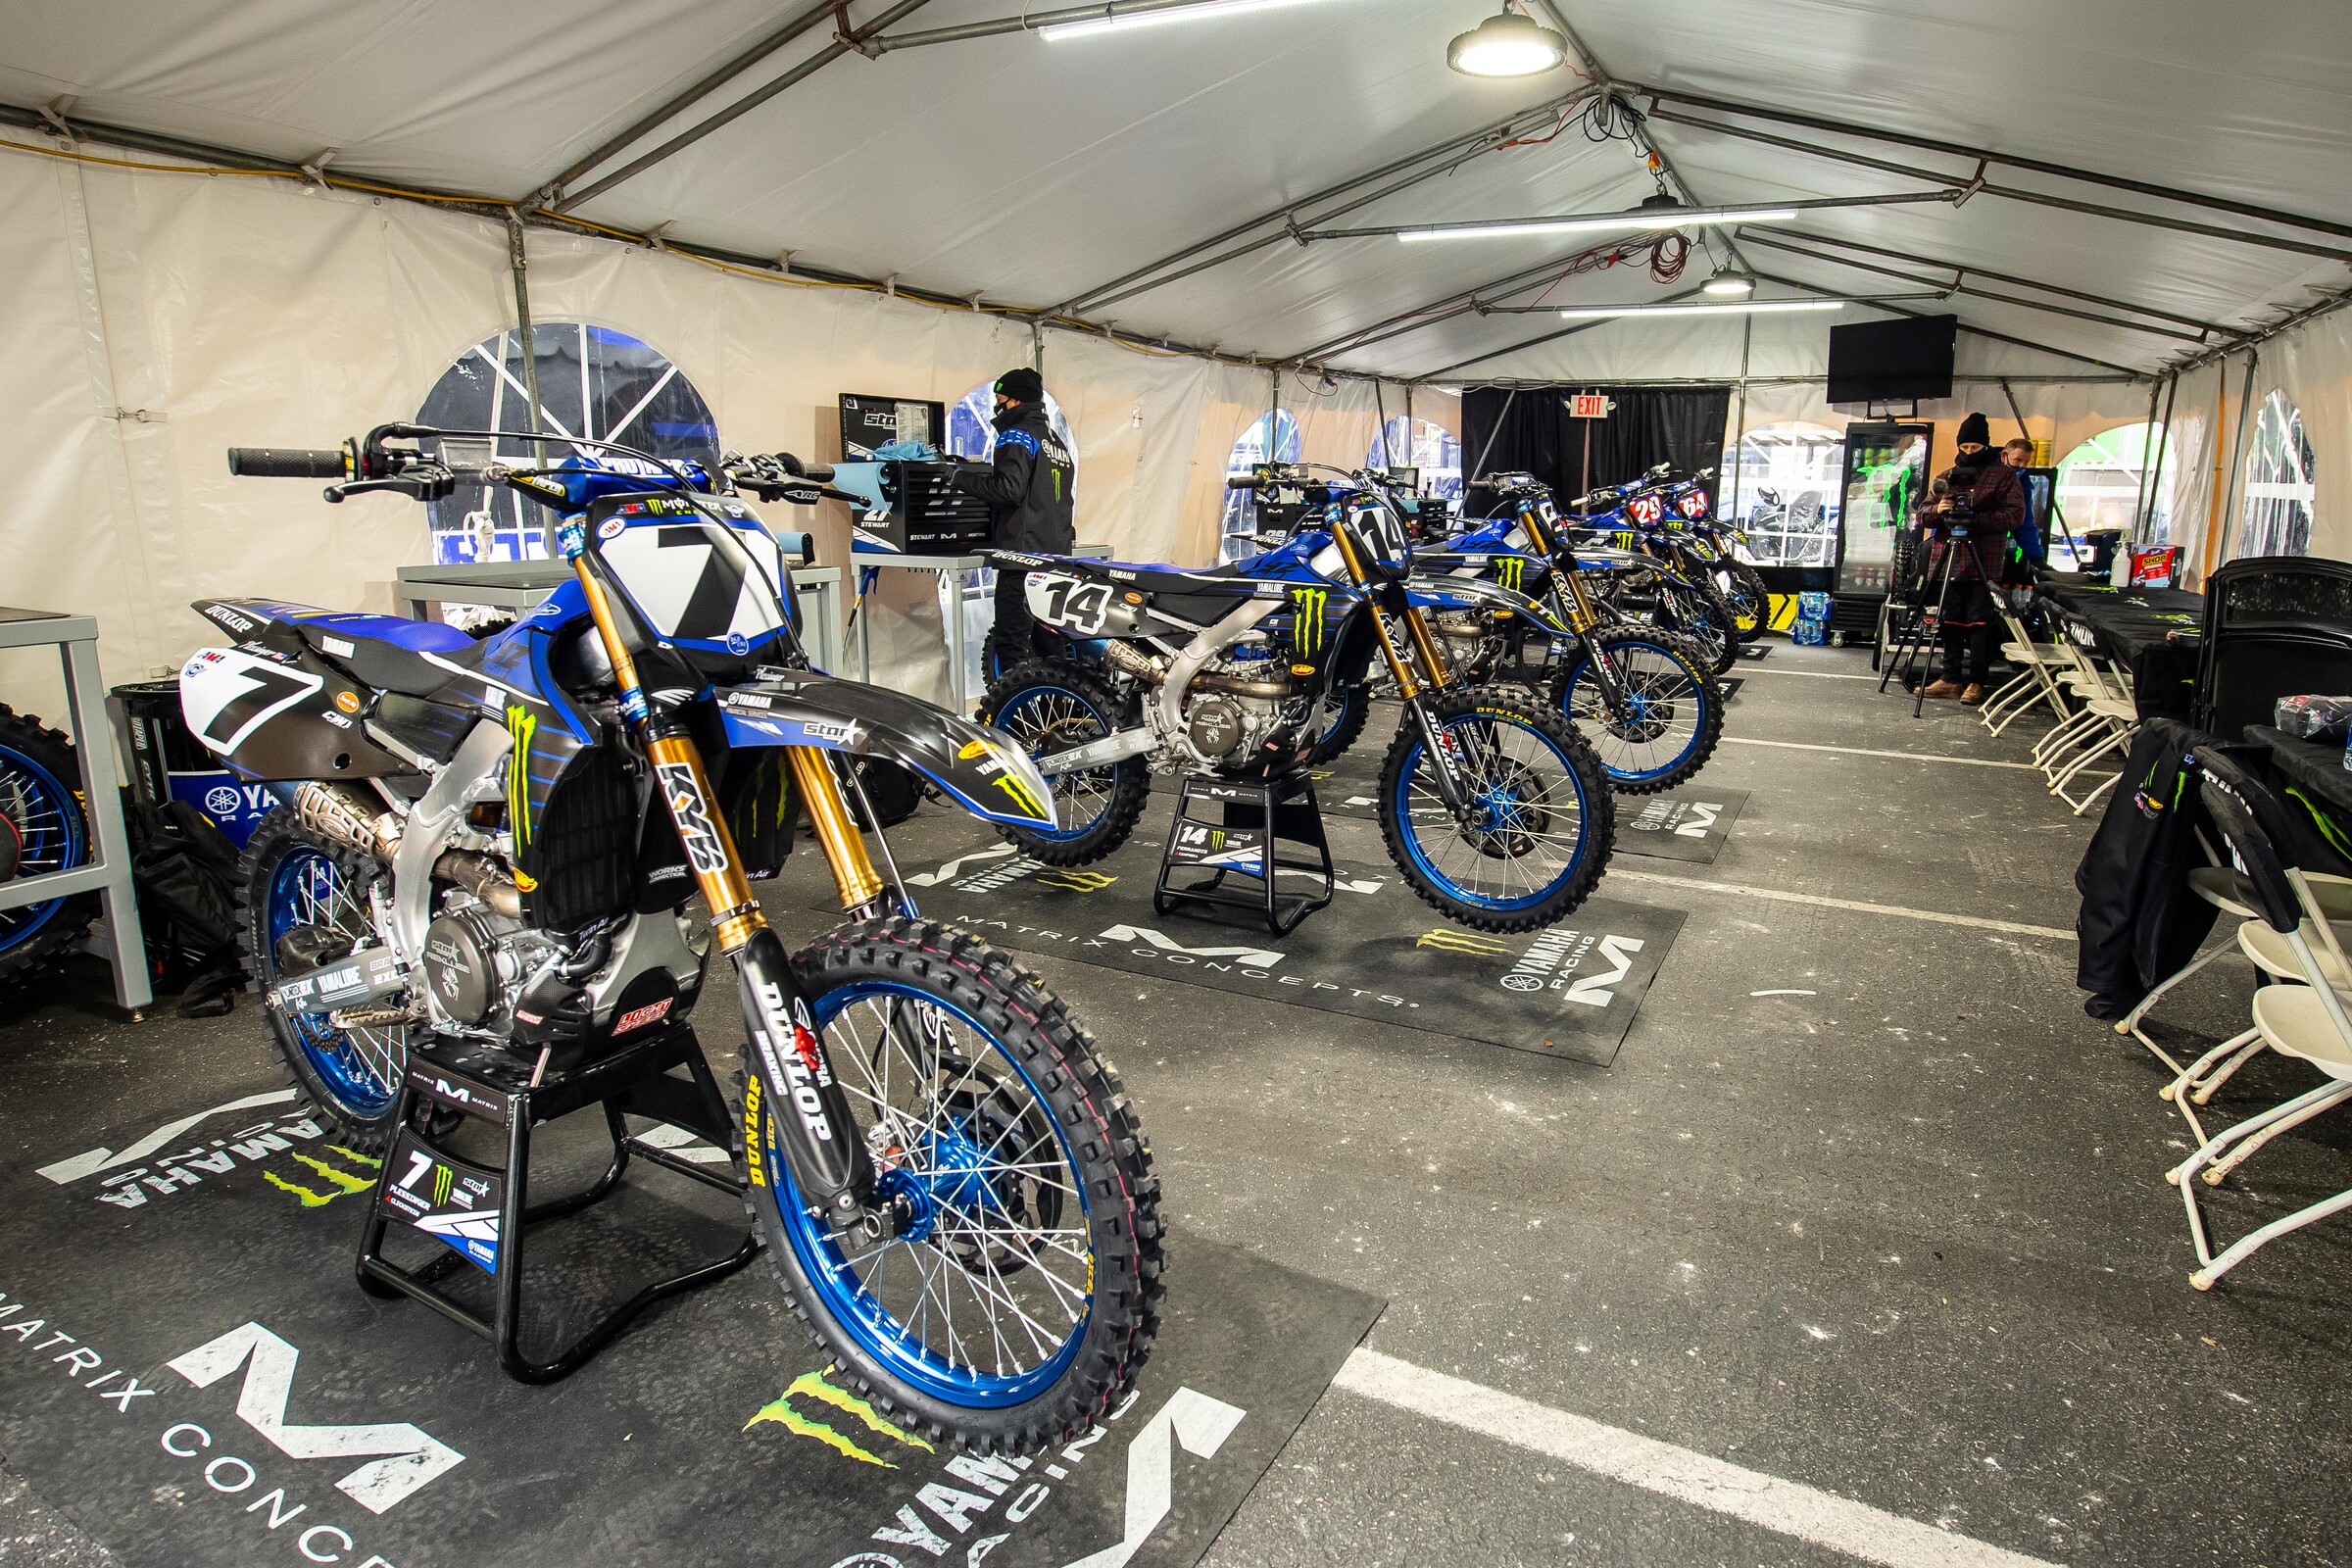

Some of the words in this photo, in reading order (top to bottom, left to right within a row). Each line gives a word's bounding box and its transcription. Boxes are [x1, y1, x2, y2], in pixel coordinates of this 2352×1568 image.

[1577, 396, 1602, 416] EXIT
[615, 503, 648, 514] AMA
[784, 490, 821, 500] ARC
[1683, 494, 1707, 517] 64
[1634, 498, 1662, 524] 29
[1357, 509, 1405, 562] 14
[992, 552, 1045, 567] DUNLOP
[2143, 555, 2167, 564] SHOP
[657, 526, 748, 641] 7
[1108, 568, 1137, 581] YAMAHA
[1045, 580, 1109, 630] 14
[204, 605, 255, 634] DUNLOP
[197, 651, 227, 663] AMA
[1672, 650, 1703, 684] DUNLOP
[203, 665, 314, 745] 7
[737, 693, 772, 710] YAMAHA
[1476, 707, 1534, 726] DUNLOP
[1425, 710, 1461, 782] DUNLOP
[1664, 802, 1690, 830] RACING
[1180, 825, 1209, 845] 14
[649, 864, 688, 878] WORKS
[956, 914, 1108, 949] MATRIX
[1510, 928, 1581, 976] YAMAHA
[1548, 935, 1595, 990] RACING
[620, 997, 674, 1025] LIGHT
[756, 980, 833, 1141] DUNLOP
[412, 1071, 434, 1085] MATRIX
[471, 1096, 498, 1111] MATRIX
[745, 1074, 766, 1188] DUNLOP
[398, 1150, 434, 1191] 7
[388, 1184, 431, 1211] PLESSINGER
[473, 1241, 495, 1261] YAMAHA
